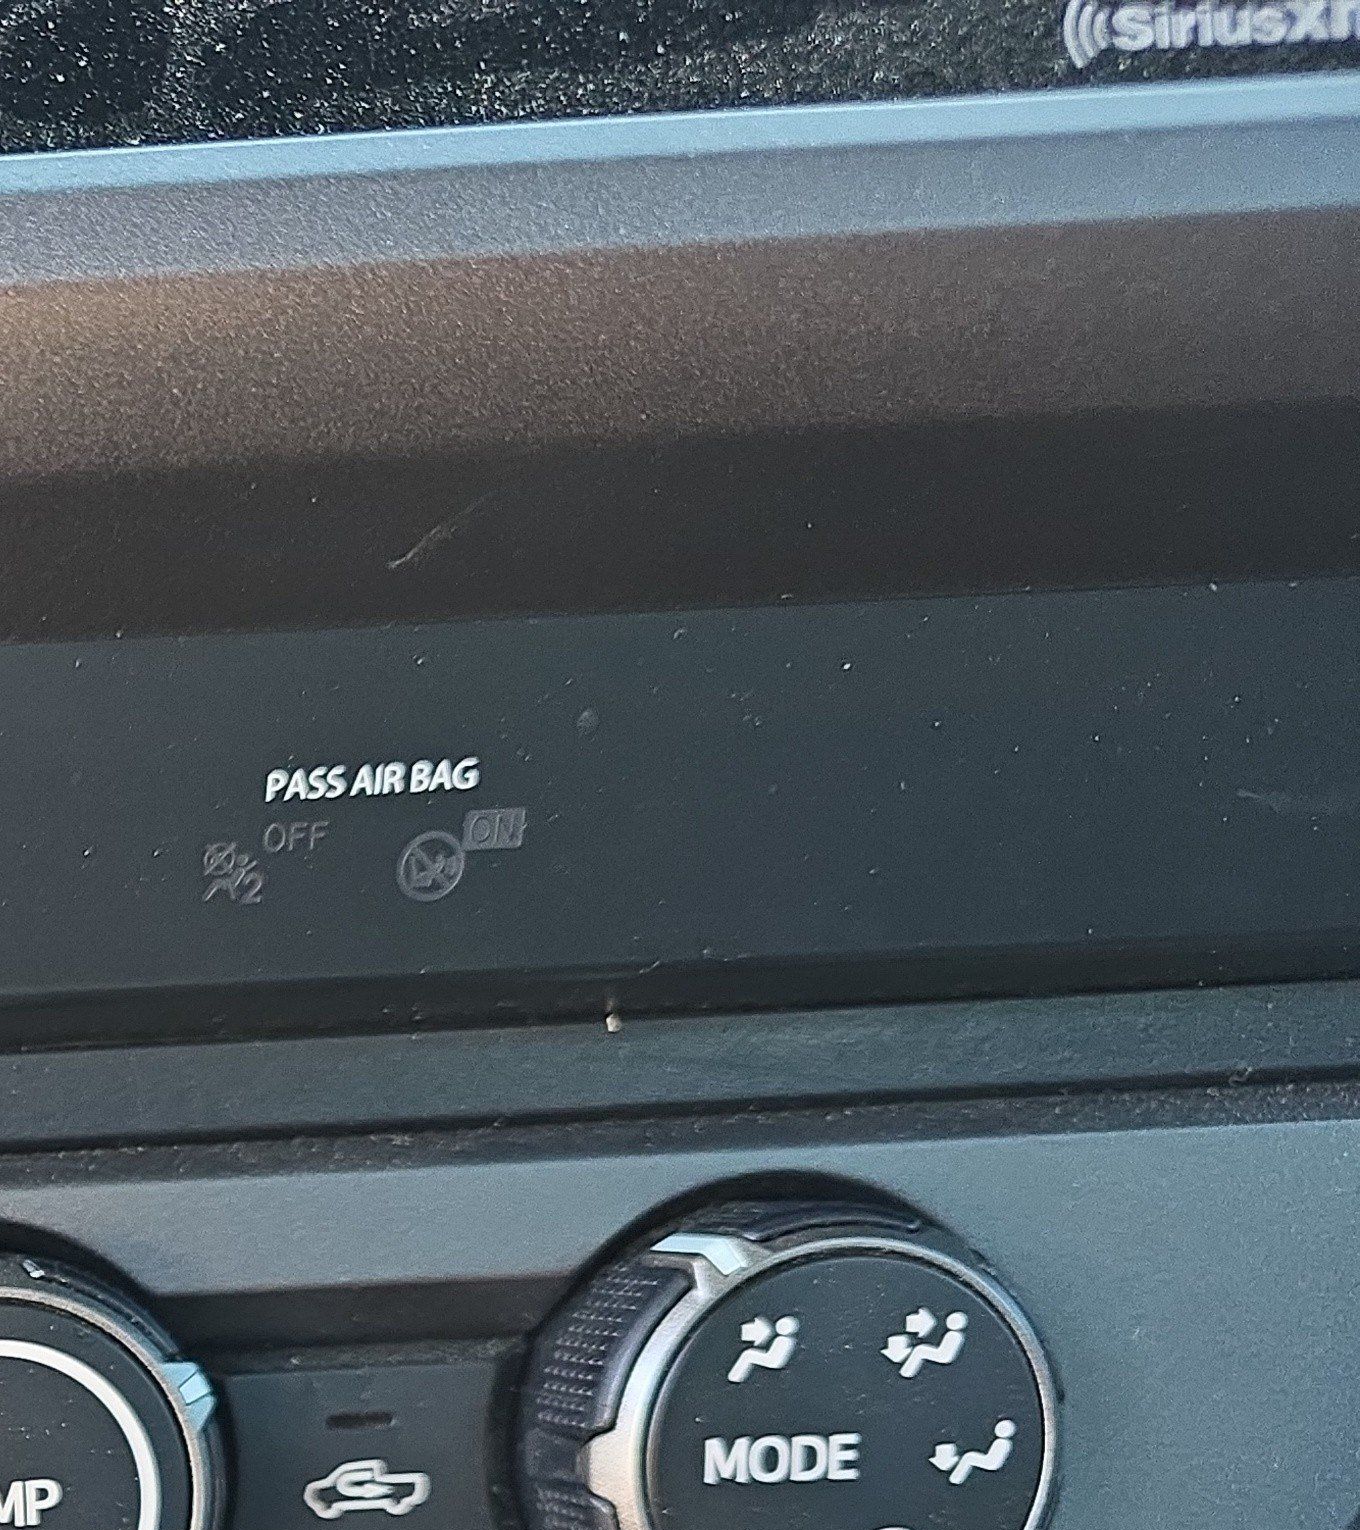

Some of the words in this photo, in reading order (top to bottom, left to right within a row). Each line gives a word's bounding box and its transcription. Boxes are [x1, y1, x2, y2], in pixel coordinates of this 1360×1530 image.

[265, 764, 347, 802] PASS
[349, 762, 406, 797] AIR
[409, 757, 480, 793] BAG
[262, 821, 330, 853] OFF
[702, 1432, 862, 1485] MODE
